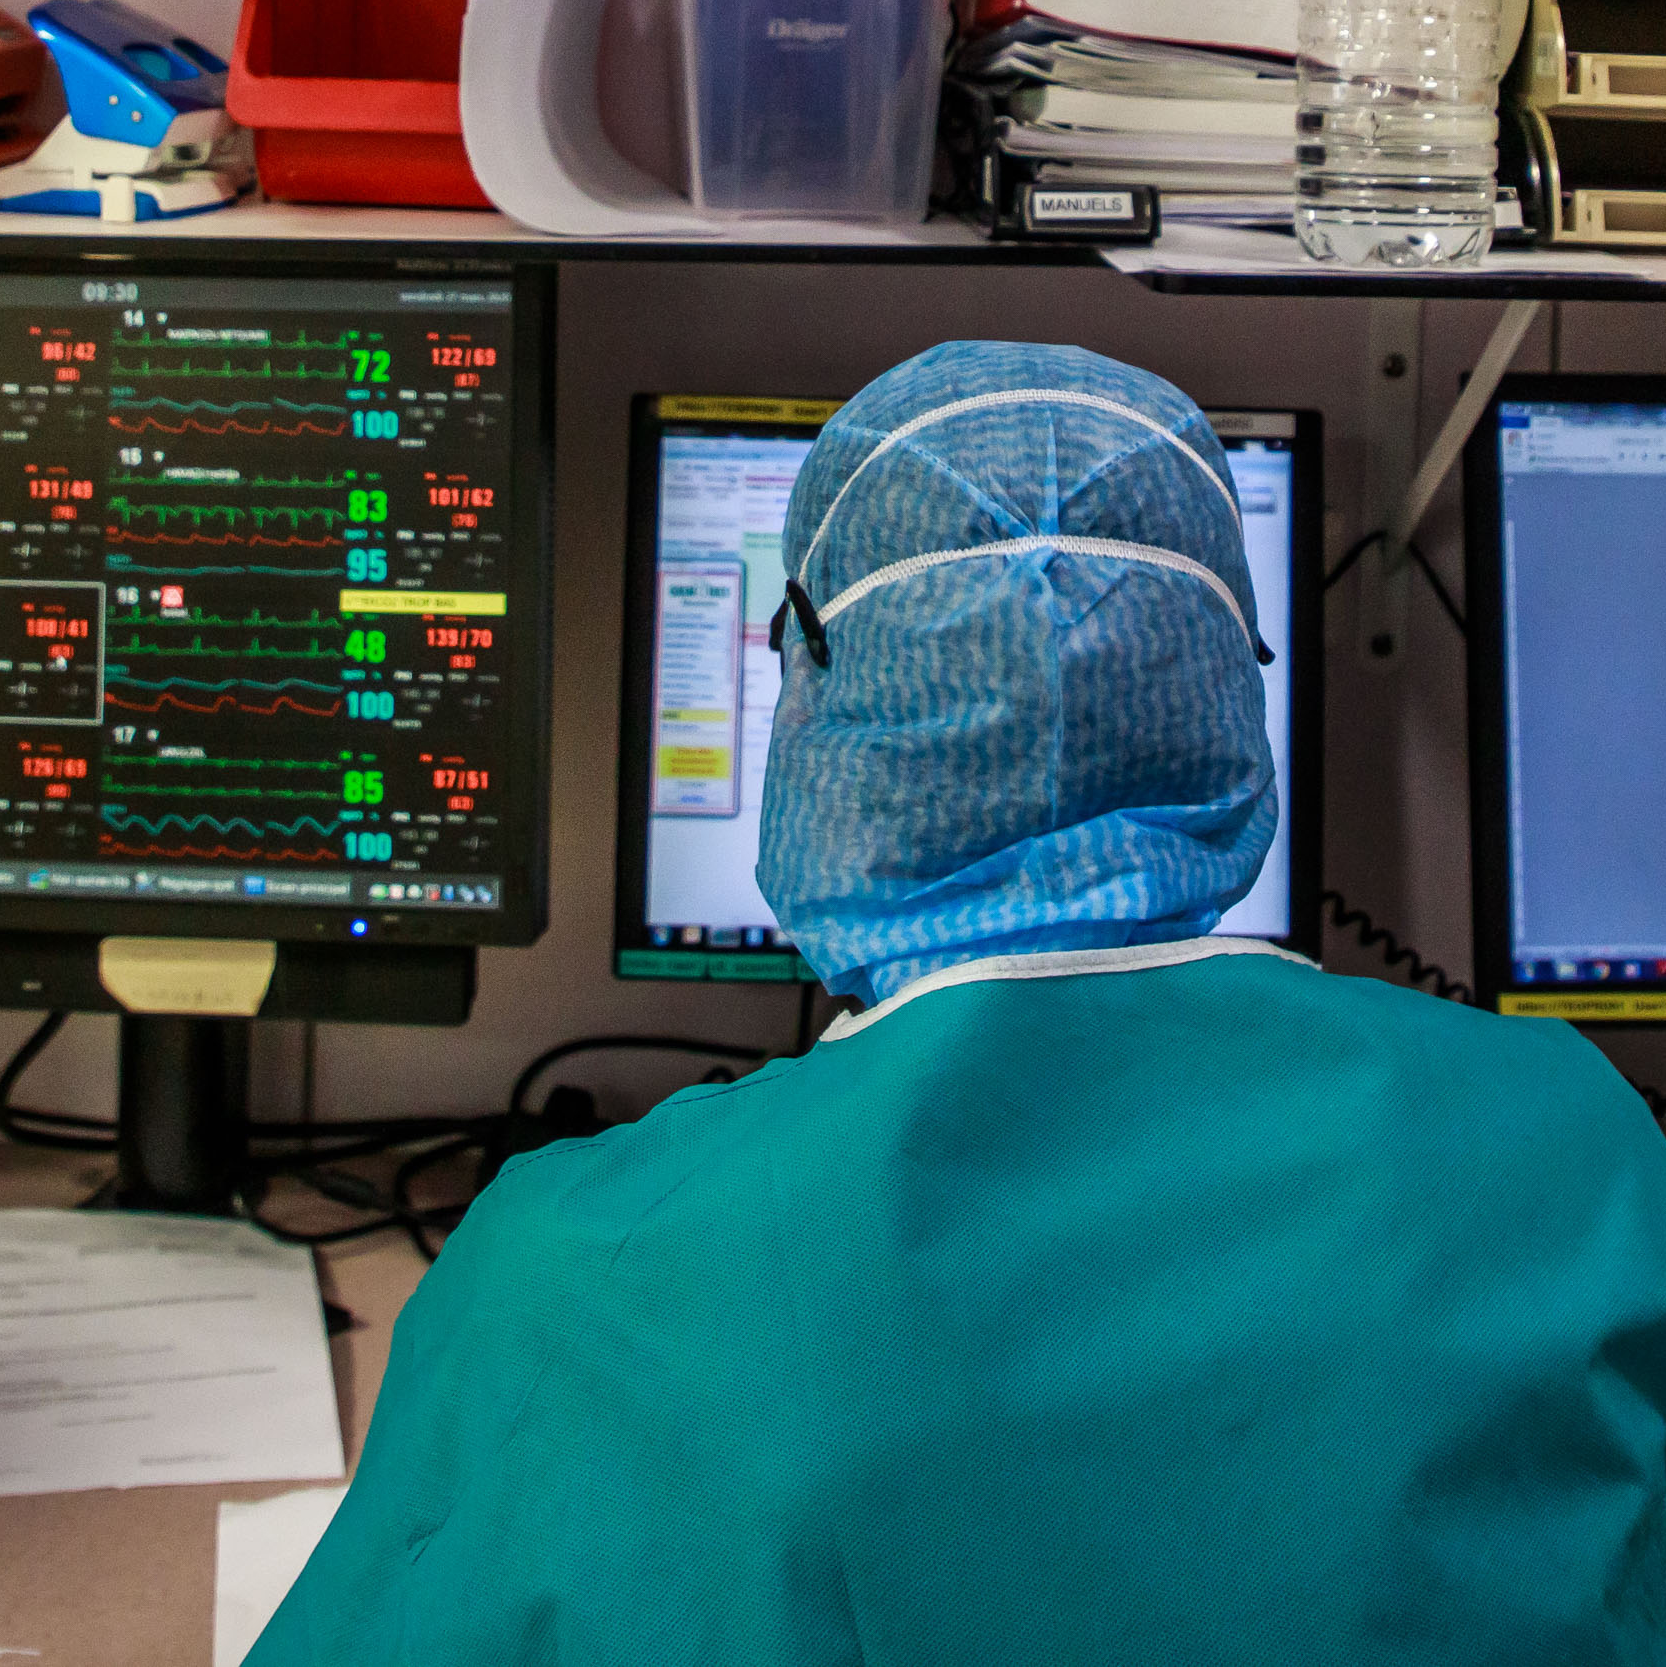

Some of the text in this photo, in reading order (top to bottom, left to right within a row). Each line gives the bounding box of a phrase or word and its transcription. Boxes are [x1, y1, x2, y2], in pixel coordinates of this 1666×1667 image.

[1040, 196, 1123, 216] MANUELS
[82, 282, 138, 302] 09:30
[351, 349, 391, 382] 72
[352, 410, 399, 440] 100
[348, 489, 388, 522] 83
[346, 548, 388, 582] 95
[344, 630, 386, 663] 48
[346, 690, 395, 722] 100
[343, 770, 384, 804] 85
[343, 832, 393, 862] 100
